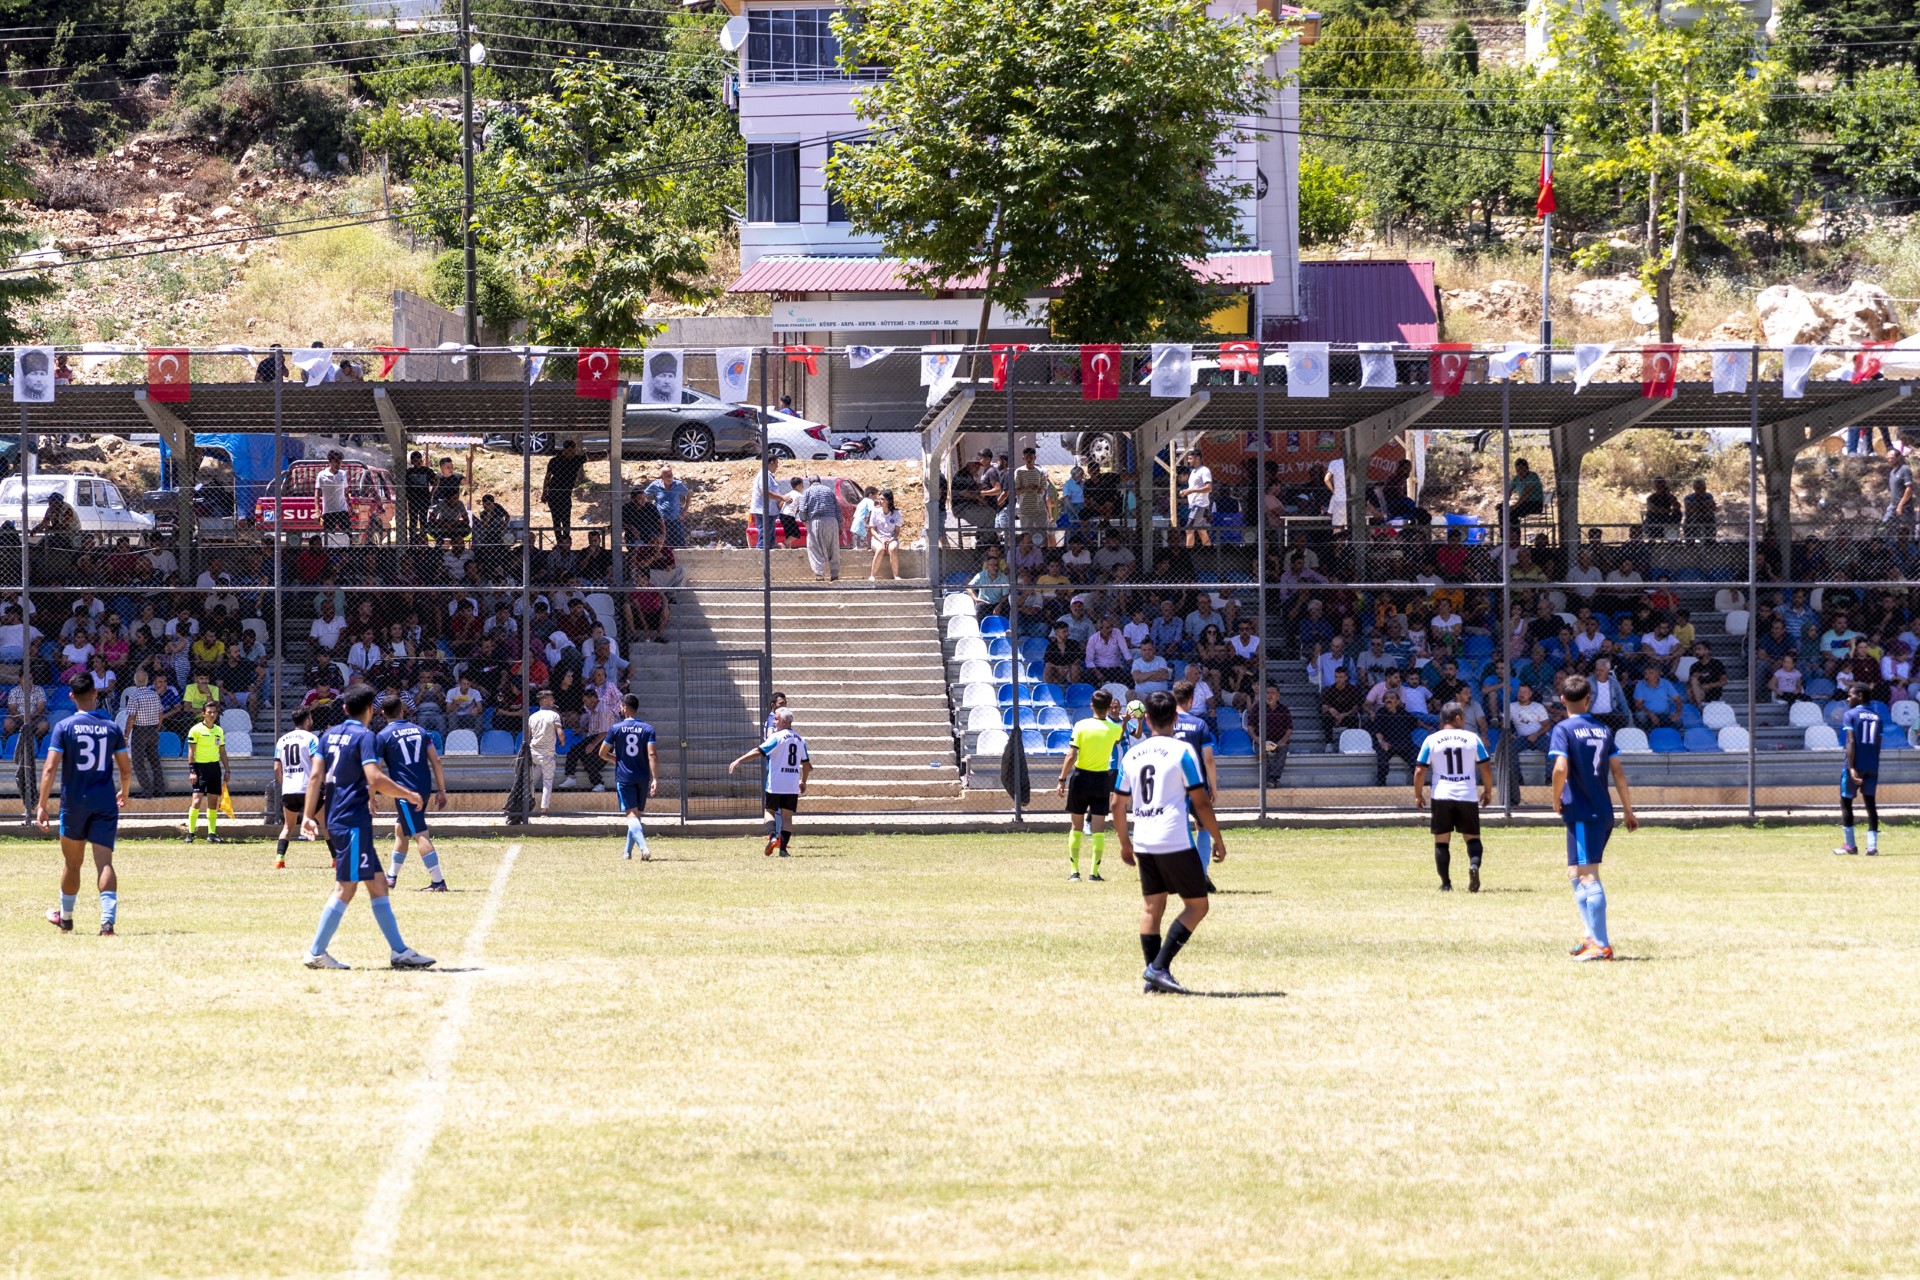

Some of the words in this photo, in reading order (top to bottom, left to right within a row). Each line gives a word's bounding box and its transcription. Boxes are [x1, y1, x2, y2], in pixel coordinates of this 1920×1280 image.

[94, 725, 108, 735] CAN
[1861, 720, 1877, 744] 11
[76, 734, 108, 772] 31
[283, 743, 301, 767] 10
[397, 734, 422, 766] 17
[625, 733, 639, 757] 8
[787, 743, 797, 766] 8
[1586, 738, 1604, 776] 7
[1443, 746, 1464, 775] 11
[1140, 763, 1156, 805] 6
